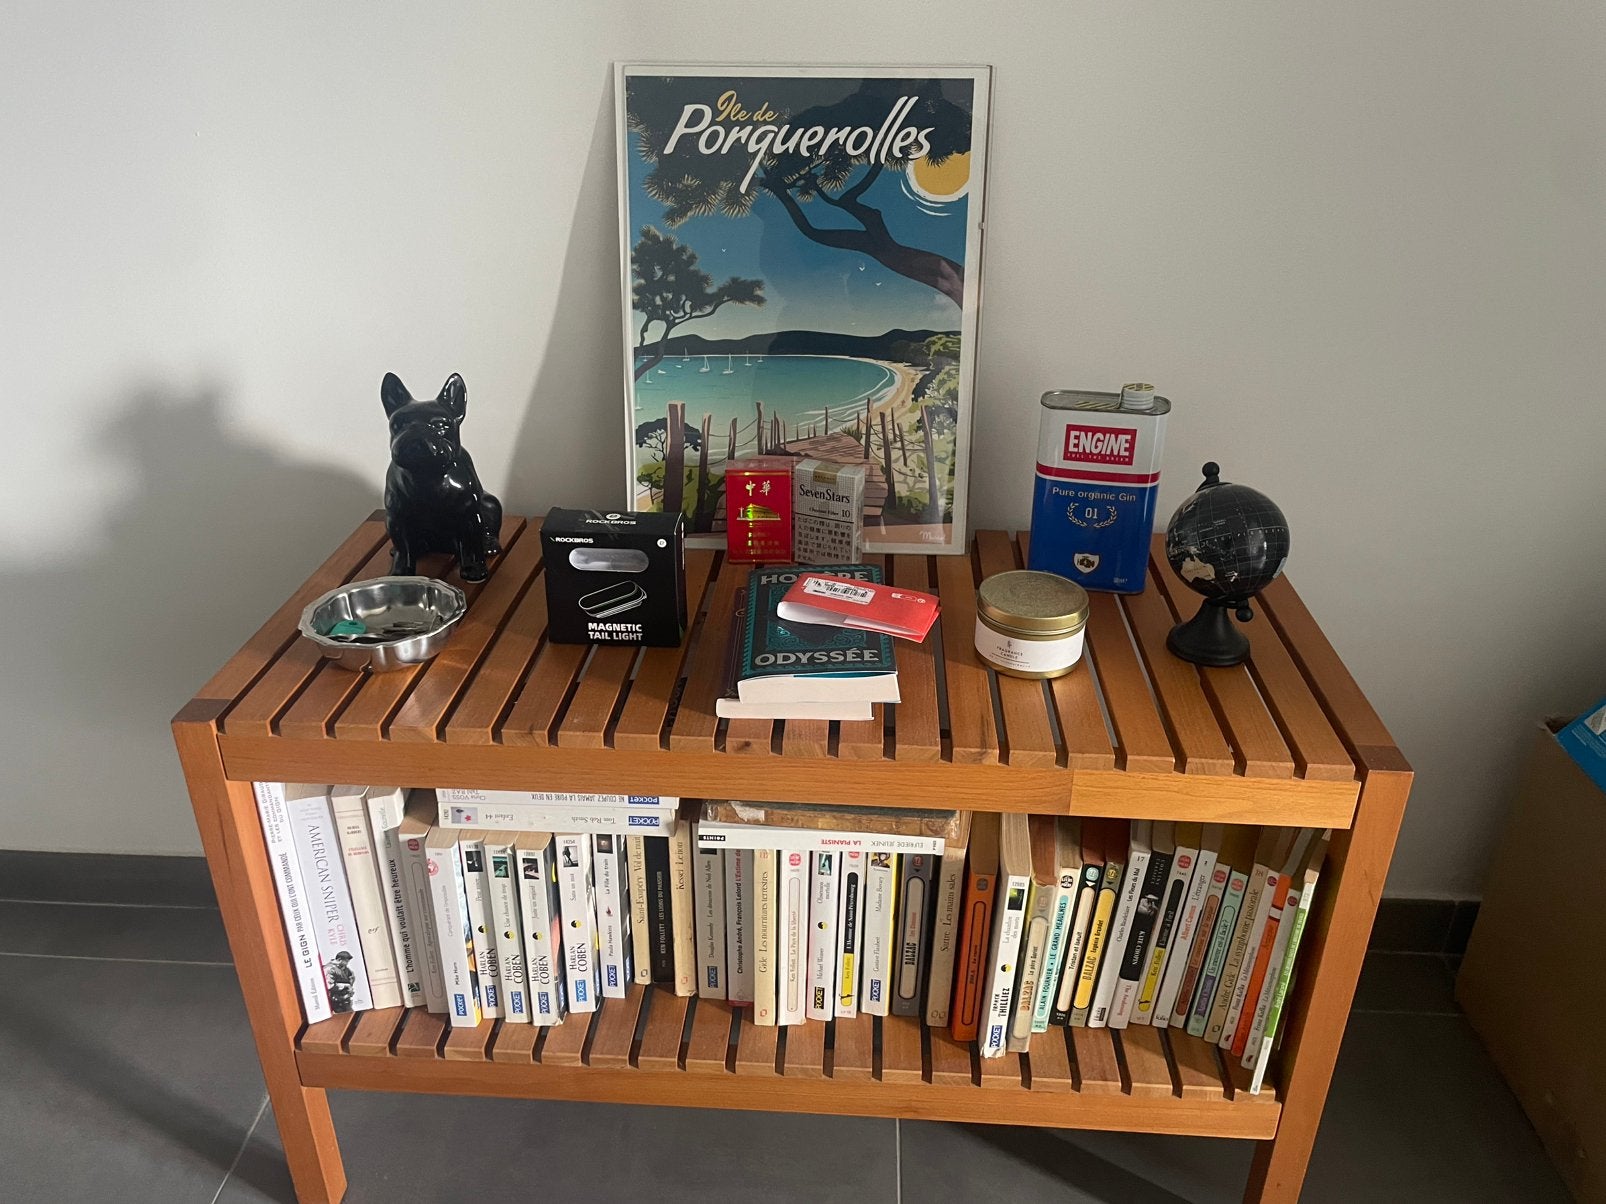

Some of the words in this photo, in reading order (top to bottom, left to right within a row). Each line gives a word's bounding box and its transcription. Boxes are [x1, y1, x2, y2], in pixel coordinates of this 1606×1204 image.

[753, 102, 779, 122] de
[663, 96, 936, 194] Porquerolles
[1068, 430, 1131, 456] ENGINE
[1052, 486, 1075, 498] Pure
[1077, 488, 1116, 501] organic
[1118, 492, 1136, 502] Gin
[841, 509, 851, 518] 10
[1085, 507, 1098, 519] 01
[588, 622, 642, 632] MAGNETIC
[588, 631, 612, 640] TAIL
[613, 632, 643, 641] LIGHT
[755, 648, 880, 666] ODYSSÉE
[996, 646, 1023, 657] FRAGRANCE
[1000, 651, 1018, 659] CANDLE
[274, 797, 283, 813] GIGN
[531, 793, 545, 801] DEUX
[546, 793, 554, 801] EN
[577, 794, 596, 802] JAMAIS
[629, 796, 659, 804] POCKET
[278, 814, 285, 824] DU
[590, 816, 601, 825] Rob
[603, 816, 617, 825] Tom
[629, 815, 659, 826] POCKET
[277, 835, 283, 843] ET
[634, 851, 642, 860] de
[279, 852, 293, 883] COMMANDÉ
[307, 824, 331, 883] AMERICAN
[319, 886, 340, 923] SNIPER
[389, 858, 401, 887] heureux
[633, 860, 642, 872] Vol
[734, 858, 742, 882] L'Estime
[1133, 867, 1141, 875] Mal
[287, 883, 298, 899] L'ONT
[759, 872, 769, 902] terrestres
[944, 873, 956, 890] sales
[1127, 881, 1138, 894] Fleurs
[393, 888, 404, 903] être
[635, 876, 647, 924] Saint-Exupéry
[734, 883, 743, 901] Lelord
[944, 891, 954, 913] mains
[1126, 894, 1134, 902] Les
[875, 893, 883, 912] Madame
[1242, 888, 1260, 920] pastorale
[397, 905, 408, 929] voulait
[706, 909, 714, 918] Les
[734, 902, 744, 926] François
[759, 902, 769, 940] nourritures
[941, 914, 951, 926] Les
[1055, 902, 1068, 930] MEAULNES
[296, 922, 305, 933] PAR
[399, 931, 411, 942] qui
[658, 923, 666, 943] FOLLETT
[1137, 930, 1146, 945] KATE
[1180, 923, 1192, 940] Albert
[299, 934, 311, 957] GIGN
[758, 940, 768, 952] Les
[939, 932, 951, 952] Sartre
[1051, 932, 1062, 951] GRAND
[1232, 920, 1251, 957] symphonie
[303, 957, 313, 969] LE
[402, 944, 415, 973] L'homme
[479, 952, 488, 976] HARLAN
[487, 948, 498, 978] COBEN
[568, 946, 577, 971] HARLAN
[575, 943, 588, 973] COBEN
[735, 945, 746, 974] Christophe
[904, 943, 917, 966] BALZAC
[1068, 952, 1078, 970] Tristan
[1229, 957, 1239, 967] La
[503, 956, 512, 981] HARLAN
[511, 954, 523, 984] COBEN
[531, 956, 540, 982] HARLAN
[538, 955, 550, 986] COBEN
[758, 957, 769, 973] Gide
[1081, 956, 1096, 981] BALZAC
[453, 974, 461, 985] Mike
[608, 965, 618, 987] POCKET
[708, 966, 718, 988] POCKET
[1020, 981, 1034, 1012] BALZAC
[1028, 959, 1038, 970] père
[1042, 968, 1054, 993] FOURNIER
[1223, 972, 1235, 989] Gide
[487, 986, 497, 1008] POCKET
[575, 980, 585, 1002] POCKET
[870, 979, 881, 1001] POCKET
[1216, 988, 1230, 1010] André
[456, 994, 467, 1015] POCKET
[511, 992, 522, 1014] POCKET
[539, 992, 549, 1014] POCKET
[998, 987, 1010, 1017] THILLIEZ
[1039, 993, 1050, 1011] ALAIN
[990, 1025, 1001, 1048] POCKET
